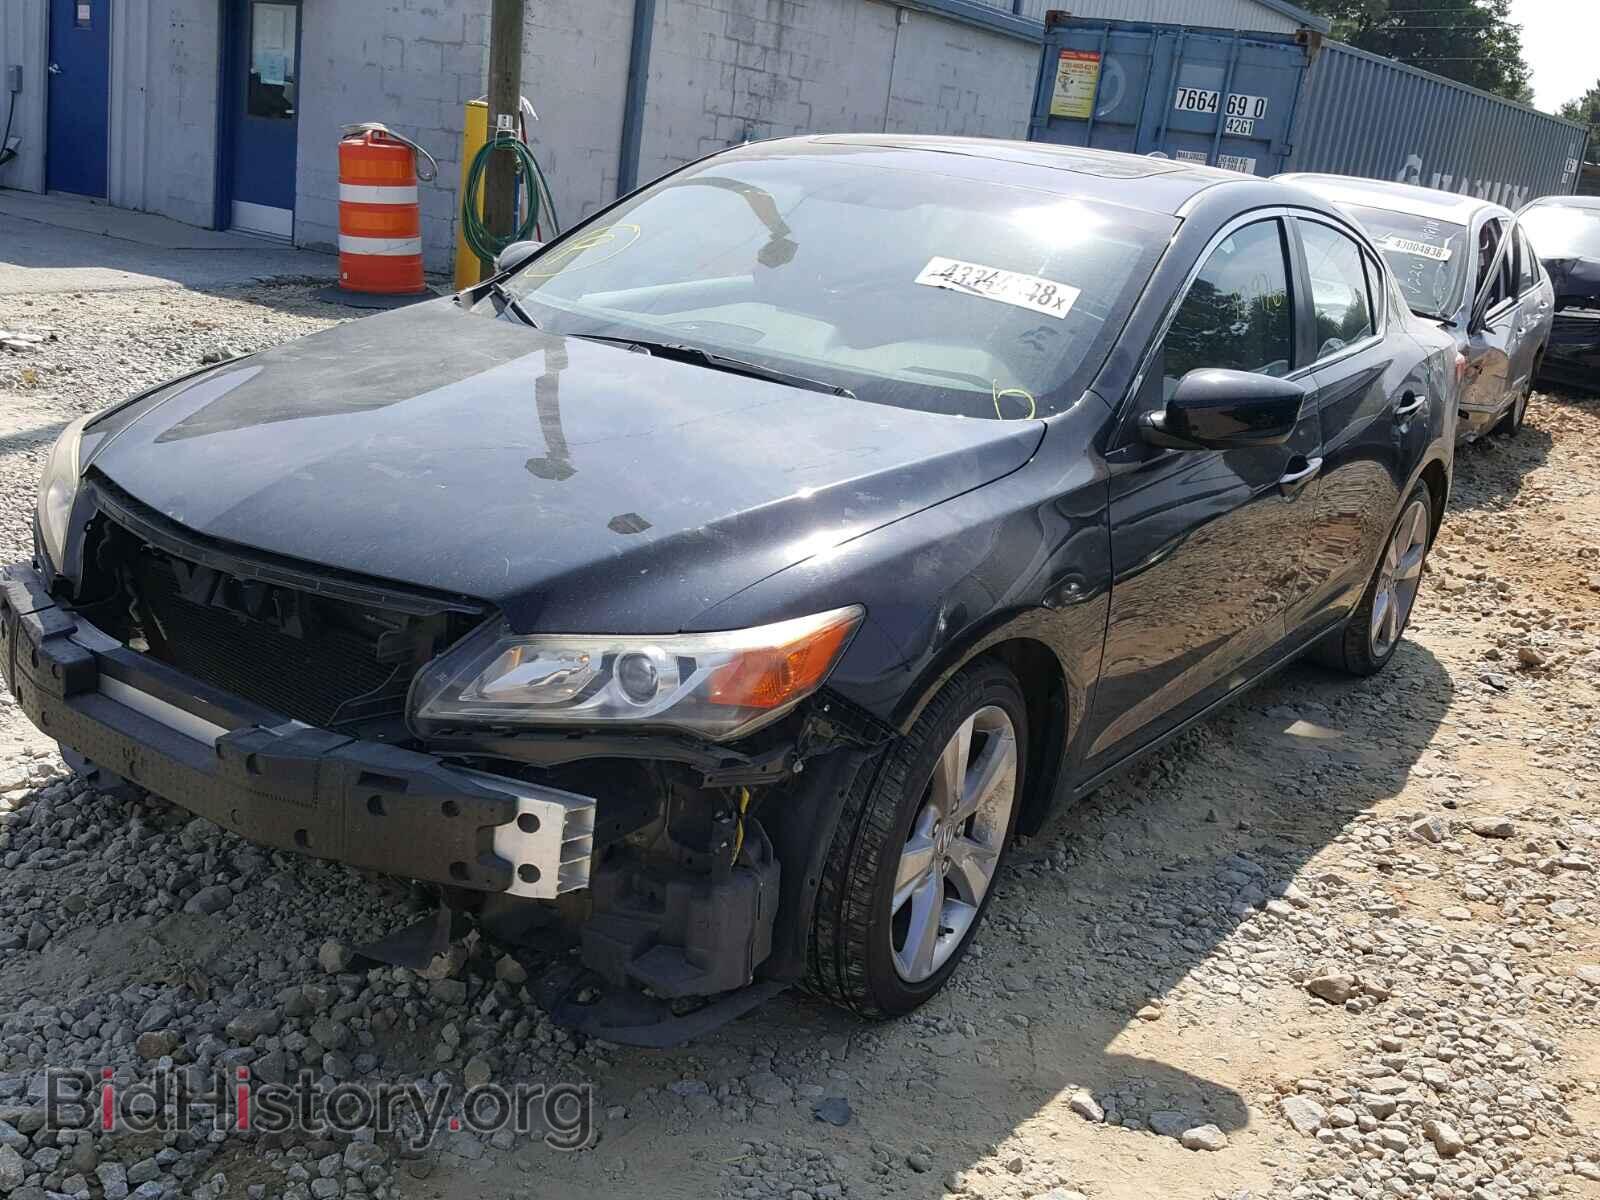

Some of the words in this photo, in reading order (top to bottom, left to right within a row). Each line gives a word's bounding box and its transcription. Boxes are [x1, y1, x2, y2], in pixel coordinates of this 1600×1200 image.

[1178, 87, 1218, 113] 7664
[1226, 95, 1248, 116] 69
[1254, 98, 1265, 118] 0
[1226, 119, 1253, 134] 42G1
